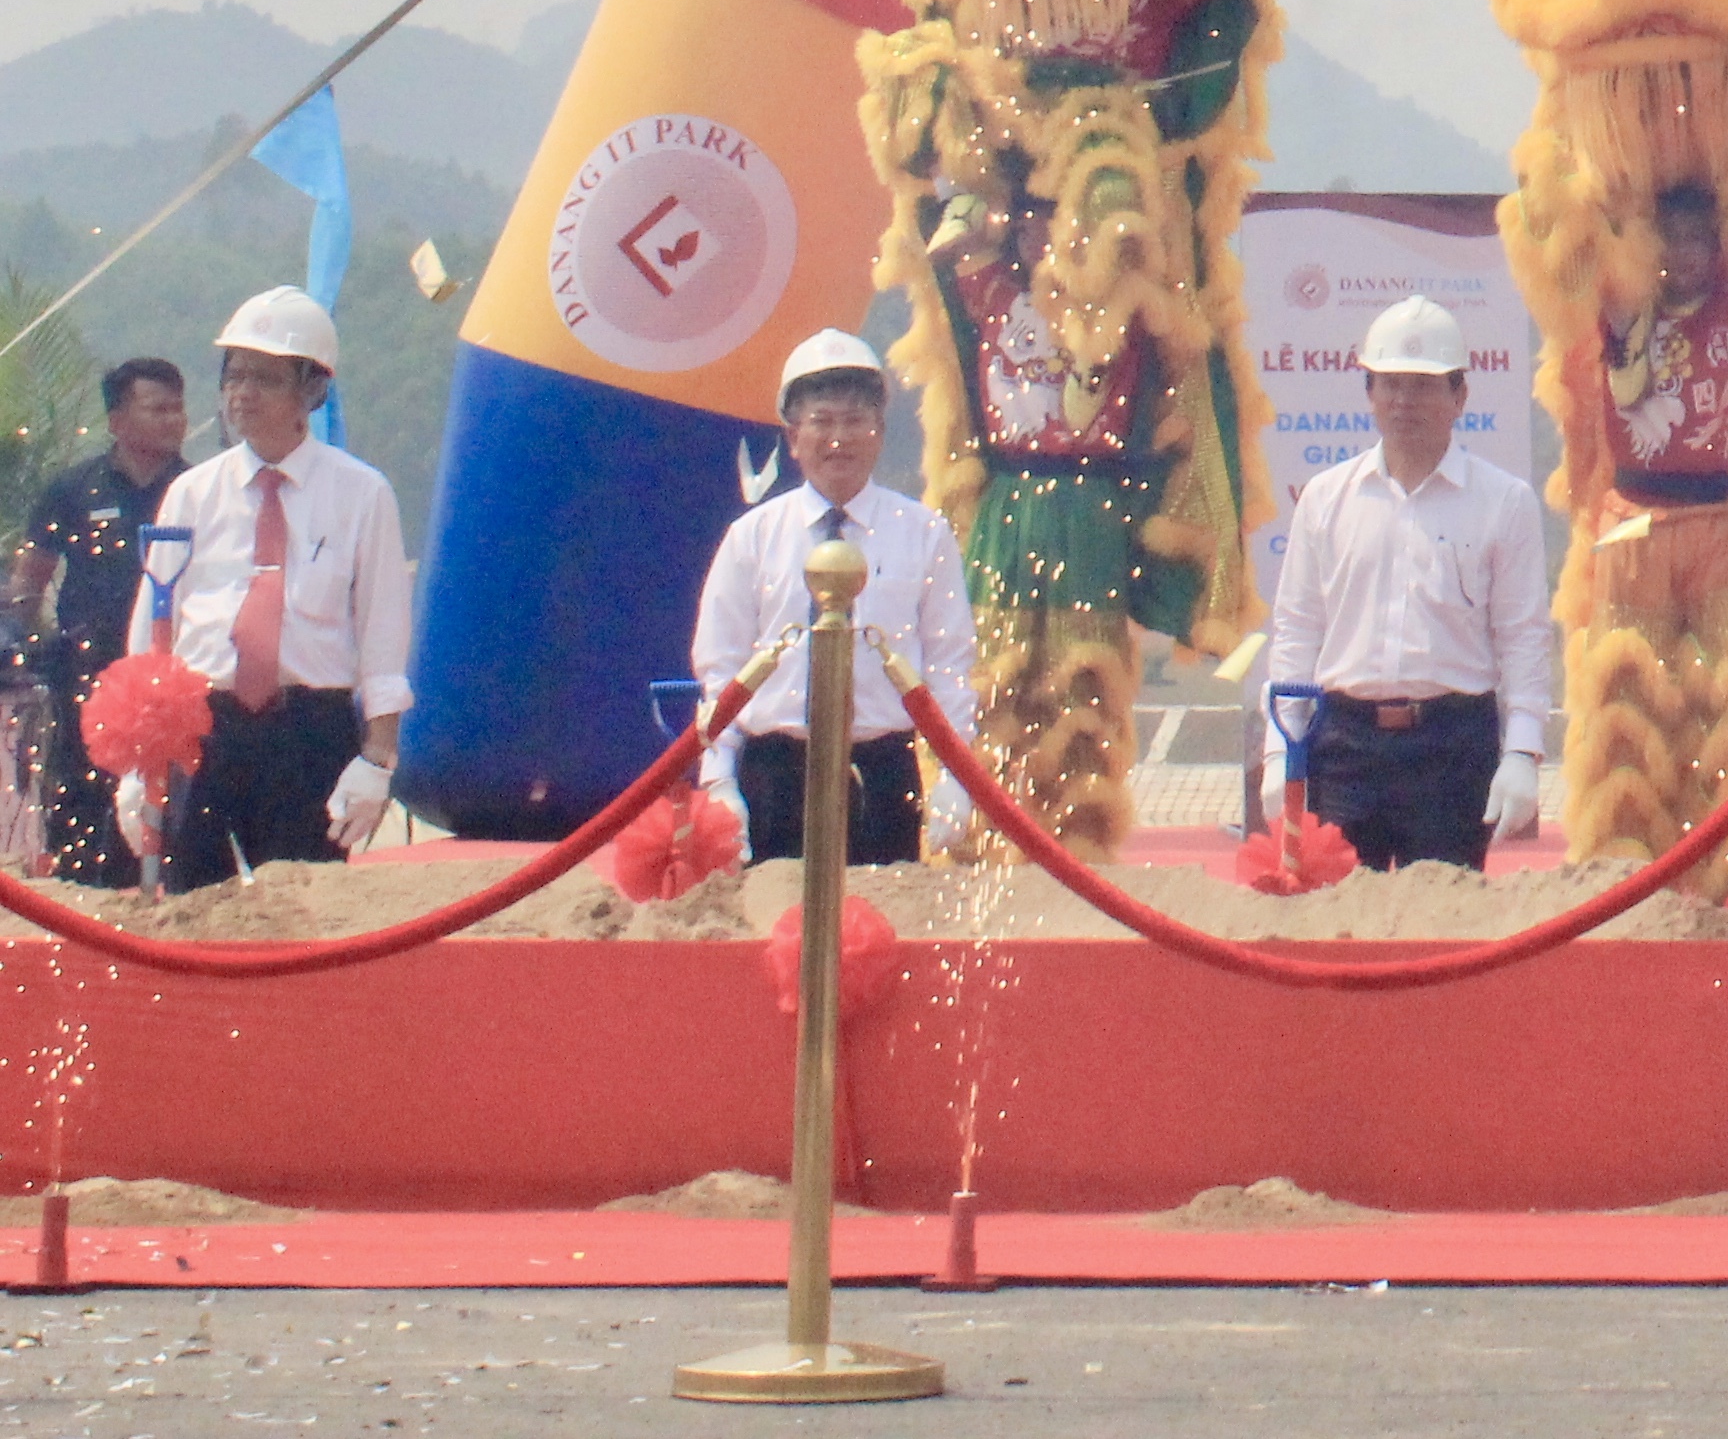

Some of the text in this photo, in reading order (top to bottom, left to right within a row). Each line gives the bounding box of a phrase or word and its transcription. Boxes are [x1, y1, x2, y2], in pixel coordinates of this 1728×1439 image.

[552, 117, 758, 329] DANANG IT PARK
[1263, 342, 1363, 372] LỄ KHÁ
[1276, 413, 1373, 432] DANAN
